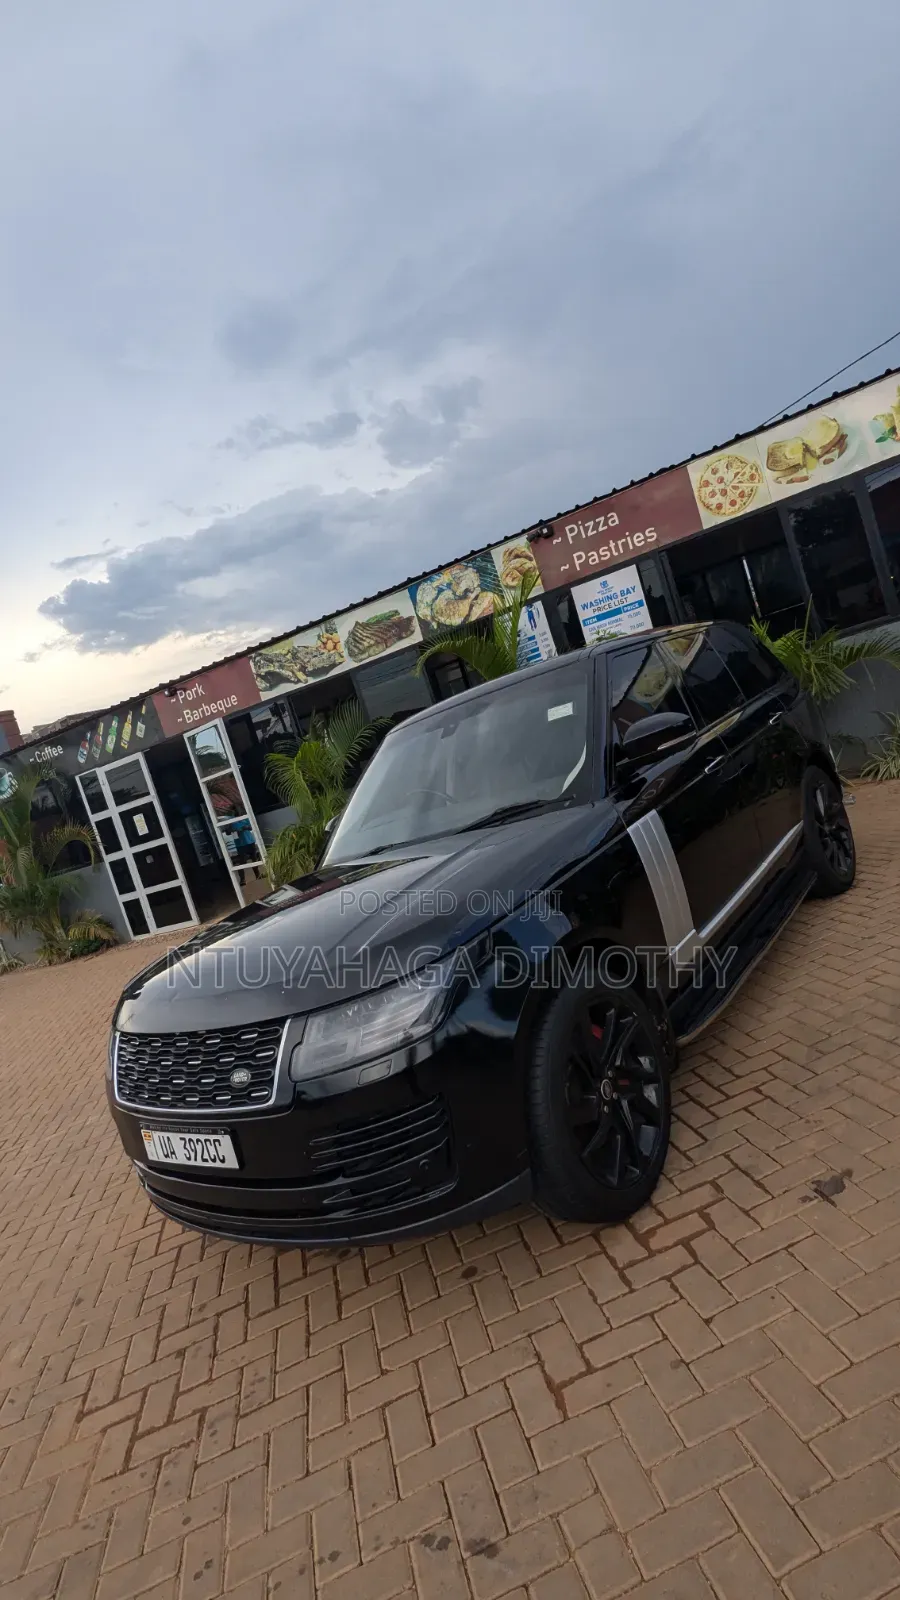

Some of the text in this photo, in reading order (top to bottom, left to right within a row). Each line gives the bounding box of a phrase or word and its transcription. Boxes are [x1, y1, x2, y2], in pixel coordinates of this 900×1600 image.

[565, 512, 619, 544] Pizza
[573, 527, 657, 570] Pastries
[581, 592, 618, 610] WASHING
[620, 586, 636, 597] BAY
[593, 597, 628, 614] PRICE LIST
[585, 603, 639, 625] ITEM PRICE
[177, 683, 205, 704] Pork
[183, 695, 238, 723] Barbeque
[35, 745, 63, 762] Coffee
[158, 1135, 225, 1164] UA 392CC
